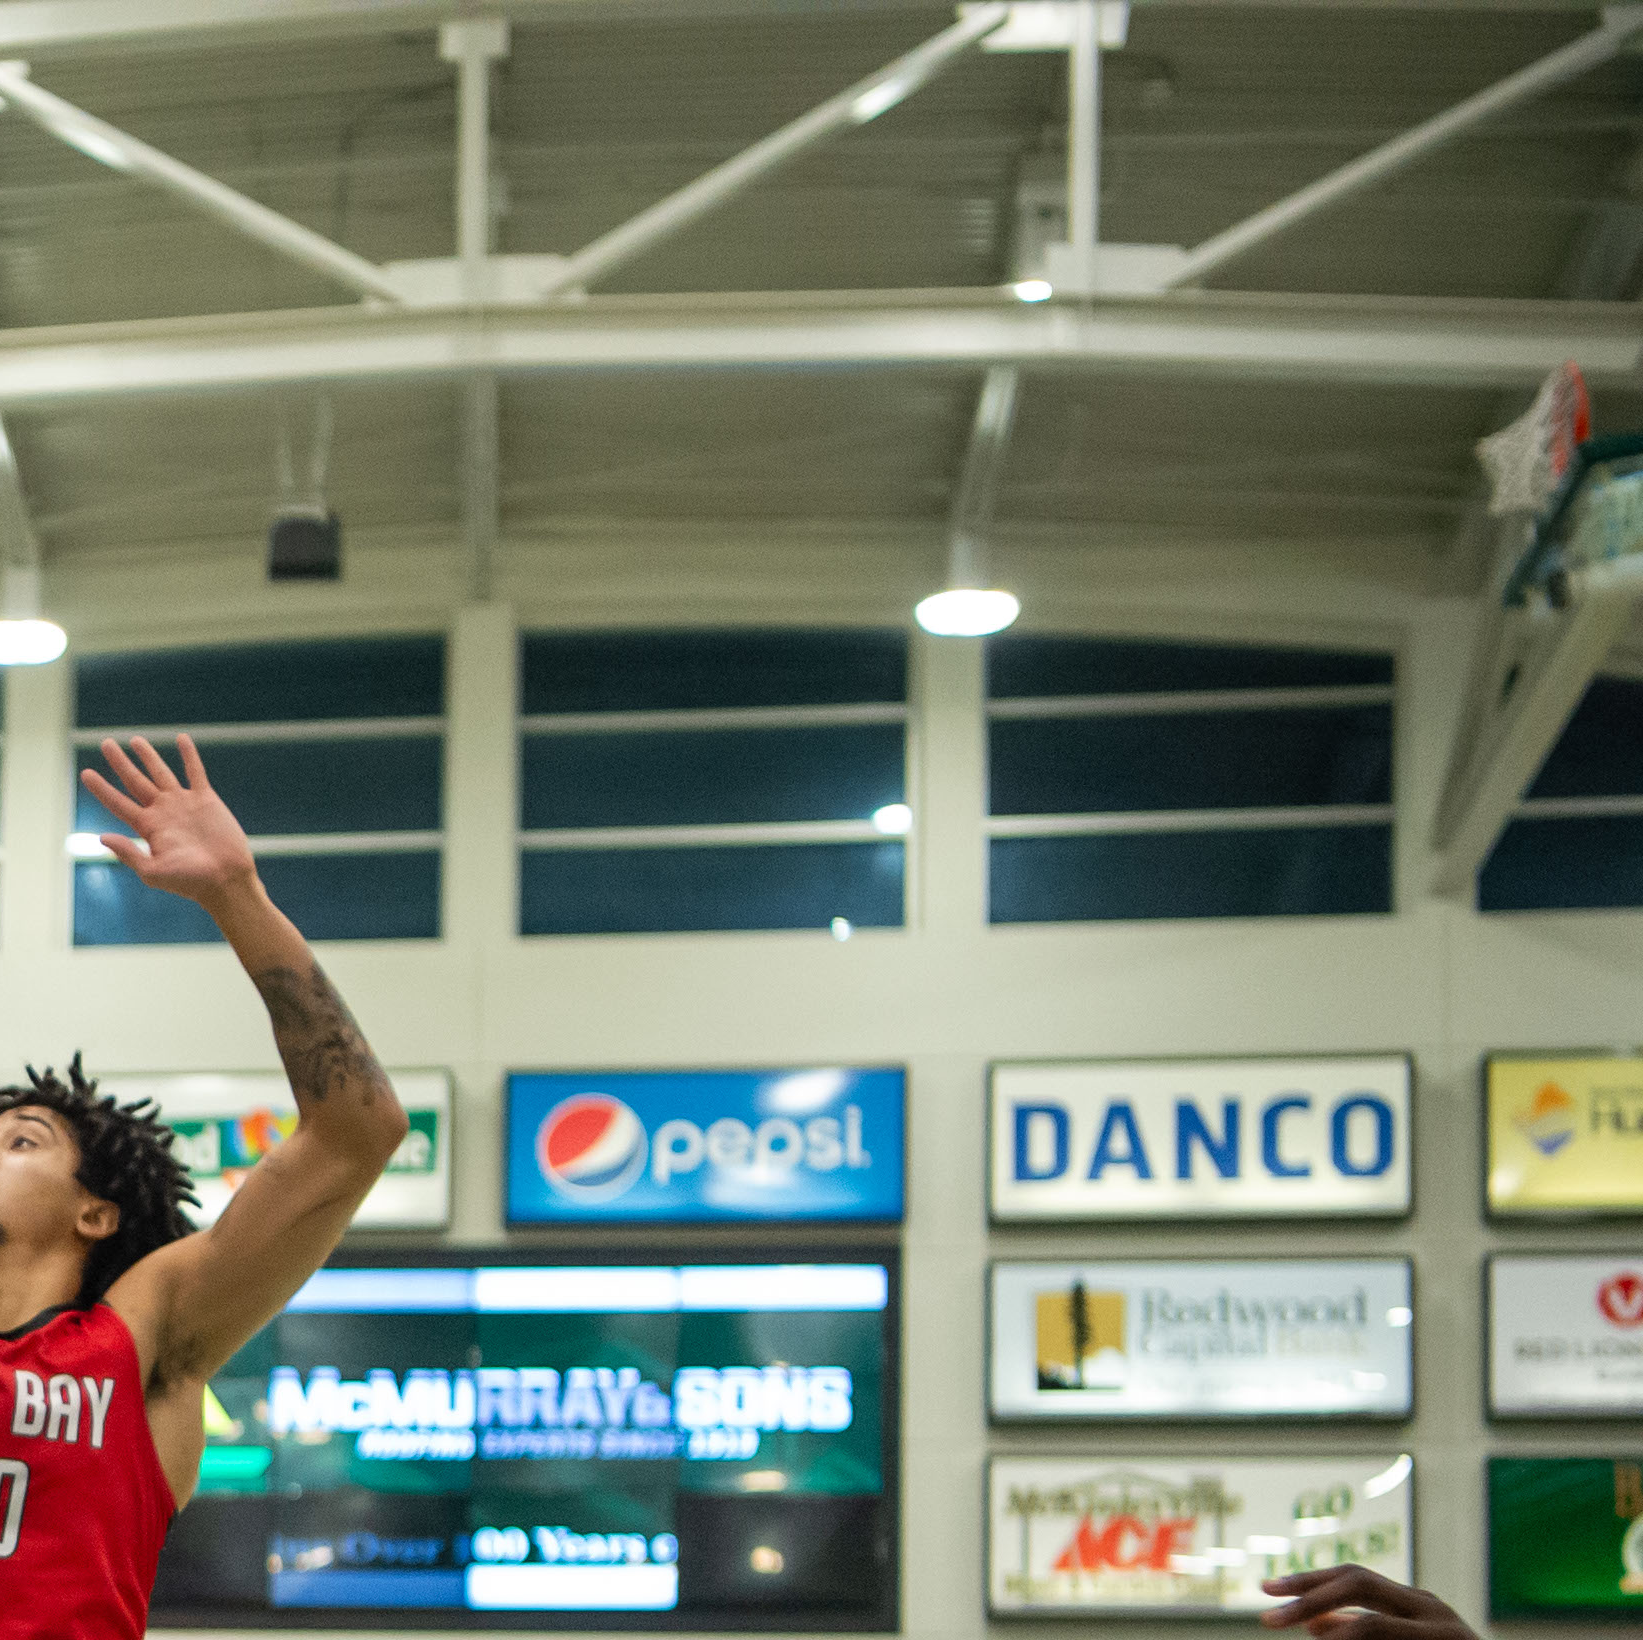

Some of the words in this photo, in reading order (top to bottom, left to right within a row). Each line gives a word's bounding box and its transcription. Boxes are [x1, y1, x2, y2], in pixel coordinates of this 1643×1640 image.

[652, 1105, 867, 1187] pepsi
[1011, 1094, 1395, 1182] DANCO
[1140, 1284, 1368, 1328] Redwood
[10, 1369, 115, 1451] BAY
[672, 1364, 854, 1434] SONS
[1053, 1514, 1196, 1572] ACE
